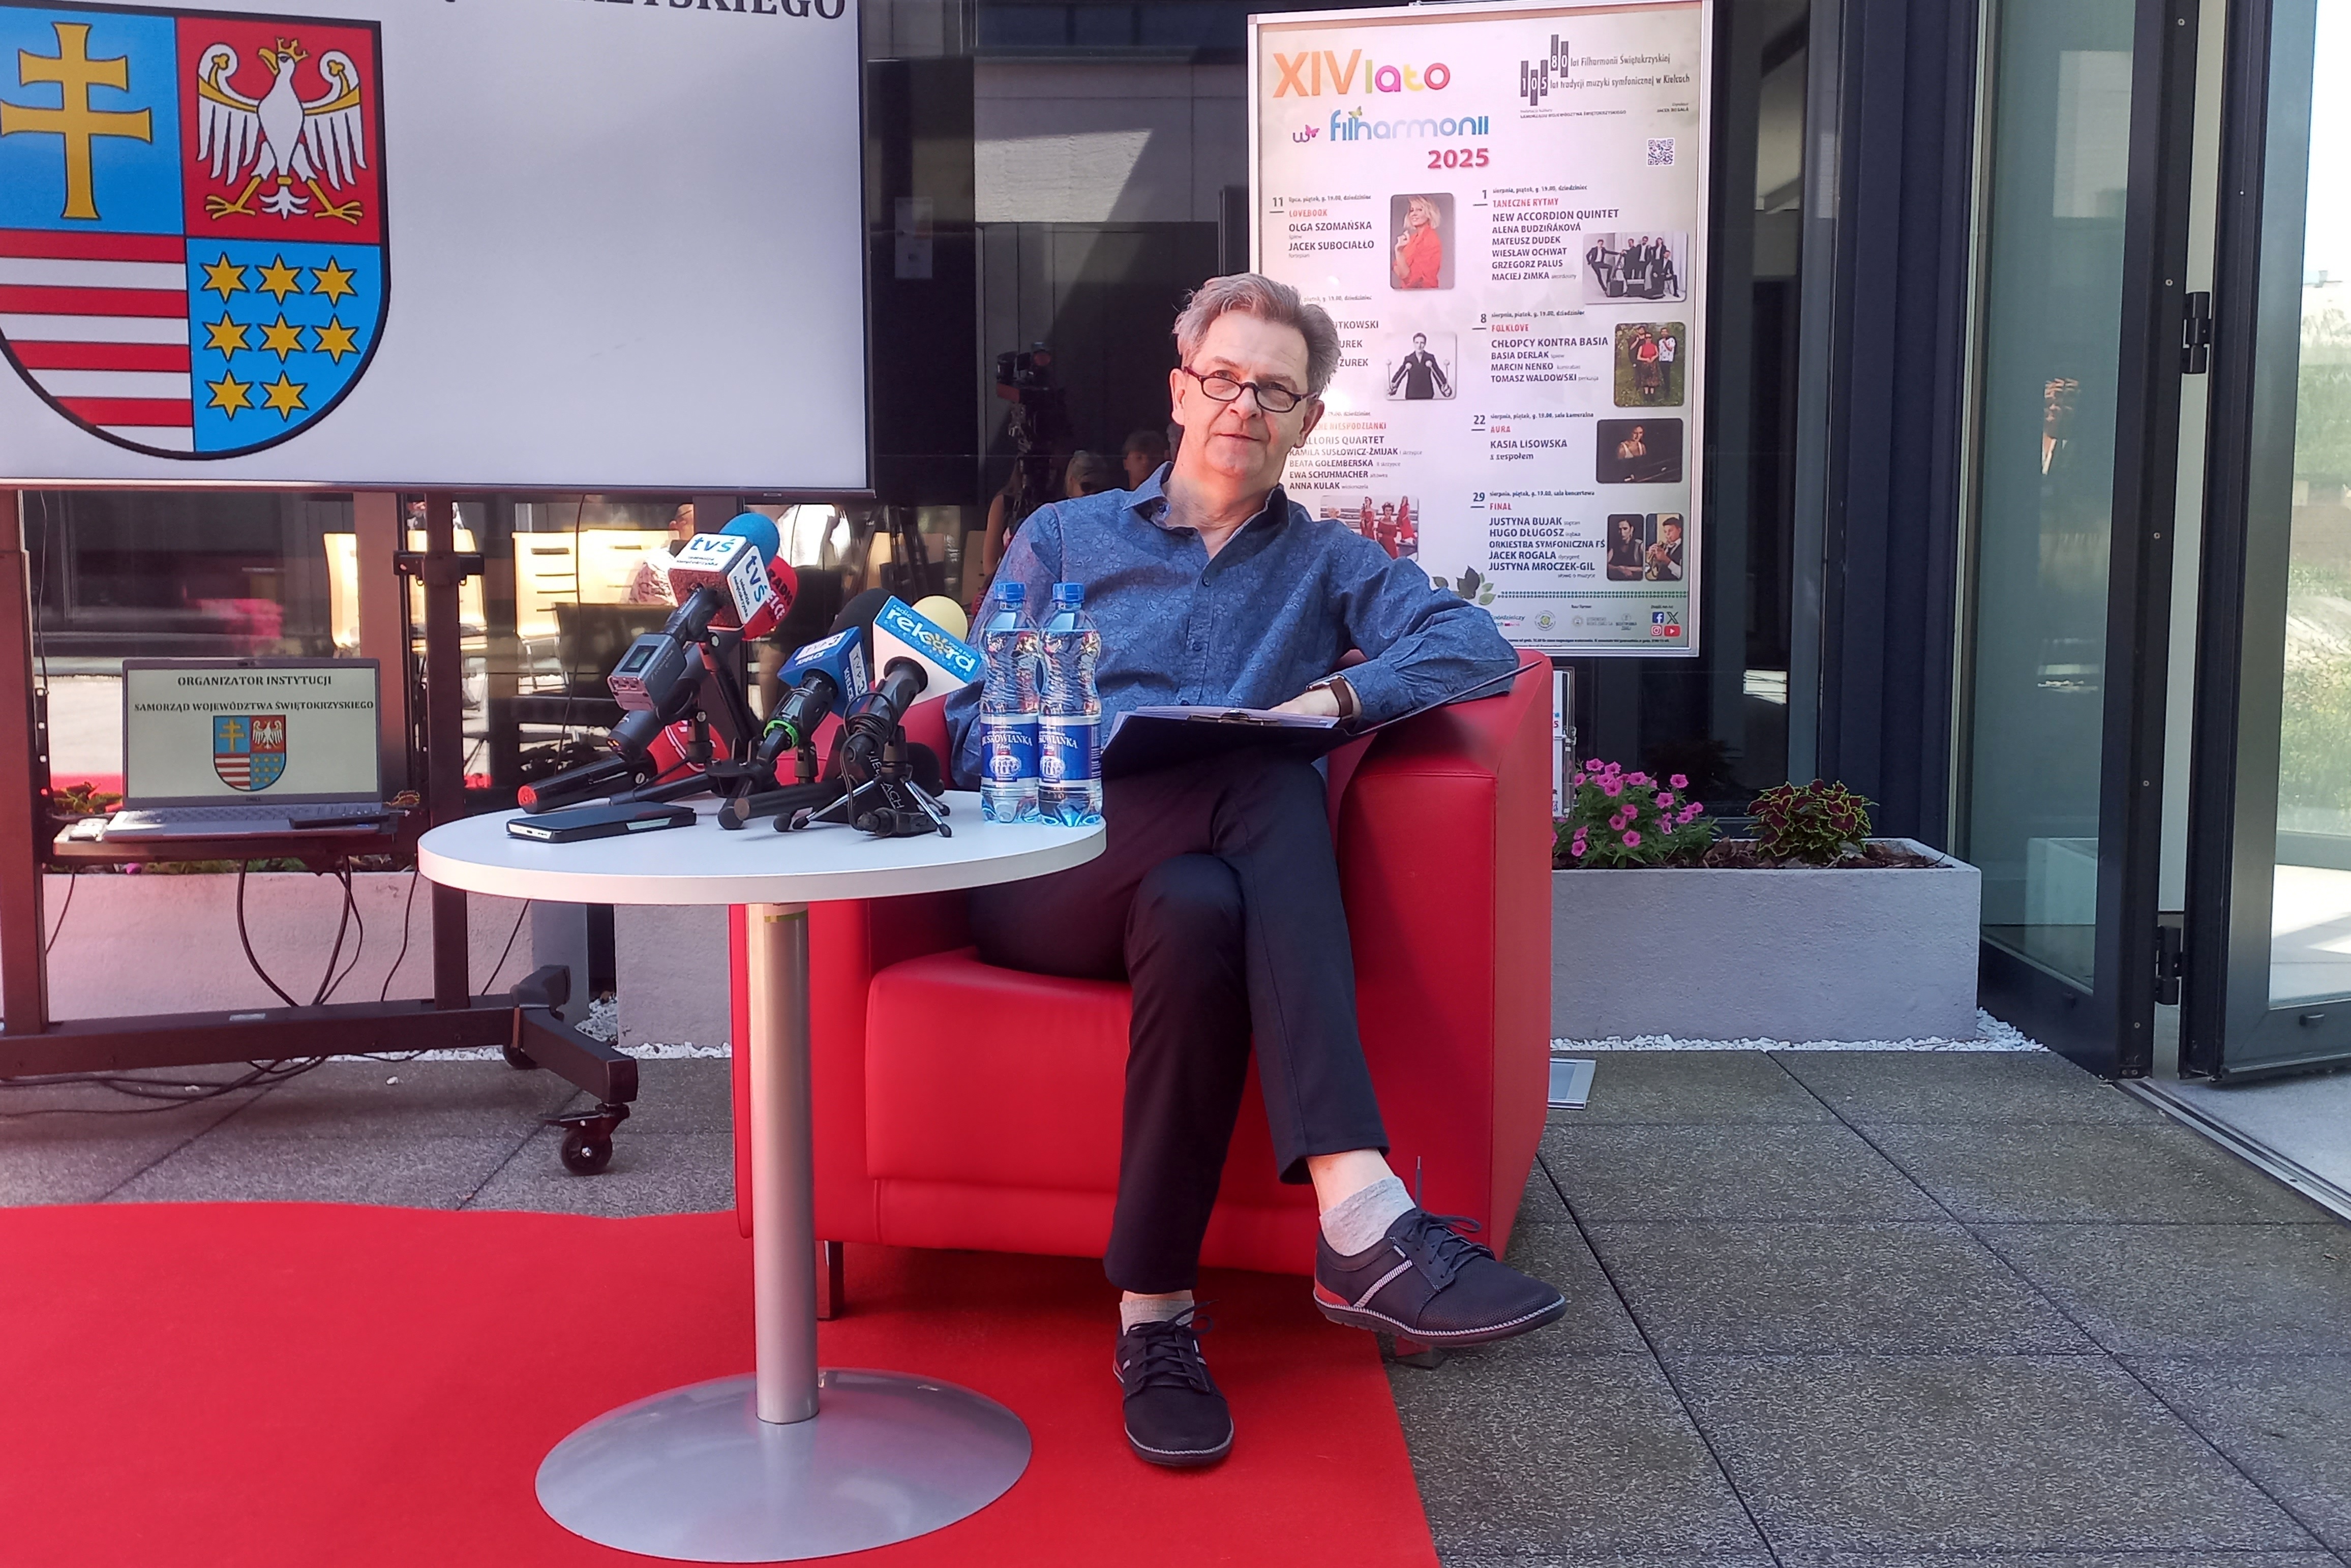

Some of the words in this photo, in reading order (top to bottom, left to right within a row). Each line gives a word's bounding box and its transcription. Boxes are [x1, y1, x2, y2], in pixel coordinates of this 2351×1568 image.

[1551, 55, 1568, 68] 80
[1571, 57, 1579, 67] lat
[1581, 56, 1618, 66] Filharmonii
[1273, 49, 1362, 98] XIV
[1366, 59, 1450, 94] lato
[1522, 76, 1547, 91] 105
[1550, 79, 1559, 88] lat
[1586, 77, 1610, 88] muzyki
[1612, 76, 1654, 87] symfonicznej
[1292, 132, 1310, 143] w
[1330, 109, 1489, 141] filharmonii
[1428, 148, 1490, 169] 2025
[1482, 190, 1487, 199] 1
[1272, 197, 1284, 207] 11
[1493, 199, 1530, 207] TANECZNE
[1532, 198, 1559, 206] RYTMY
[1289, 209, 1328, 217] LOVEBOOK
[1492, 213, 1515, 222] NEW
[1517, 210, 1574, 221] ACCORDION
[1576, 209, 1619, 220] QUINTET
[1289, 223, 1313, 232] OLGA
[1315, 220, 1372, 231] SZOMAŃSKA
[1288, 242, 1316, 251] JACEK
[1318, 240, 1374, 250] SUBOCIAŁŁO
[1492, 236, 1530, 245] MATEUSZ
[1532, 236, 1561, 244] DUDEK
[1492, 248, 1530, 257] WIESŁAW
[1532, 248, 1568, 256] OCHWAT
[1492, 260, 1535, 269] GRZEGORZ
[1537, 259, 1563, 267] PALUS
[1492, 272, 1521, 281] MACIEJ
[1523, 272, 1550, 280] ZIMKA
[1481, 313, 1487, 323] 8
[1339, 340, 1363, 348] UREK
[1491, 339, 1535, 348] CHŁOPCY
[1538, 338, 1577, 347] KONTRA
[1579, 337, 1608, 346] BASIA
[1491, 352, 1515, 360] BASIA
[1517, 351, 1549, 359] DERLAK
[1491, 363, 1523, 371] MARCIN
[1525, 362, 1553, 371] NENKO
[1491, 374, 1524, 383] TOMASZ
[1526, 373, 1577, 382] WALDOWSKI
[1473, 415, 1486, 425] 22
[1342, 436, 1384, 445] QUARTET
[1490, 440, 1518, 449] KASIA
[1520, 439, 1568, 448] LISOWSKA
[1496, 453, 1534, 462] zespołem
[1308, 470, 1368, 478] SCHUHMACHER
[1314, 481, 1340, 490] KULAK
[1473, 492, 1485, 502] 29
[1489, 517, 1530, 526] JUSTYNA
[1532, 517, 1562, 526] BUJAK
[1489, 529, 1517, 537] HUGO
[1520, 528, 1564, 537] DŁUGOSZ
[690, 536, 736, 553] tvś
[1489, 540, 1533, 549] ORKIESTRA
[1535, 540, 1594, 548] SYMFONICZNA
[1489, 551, 1517, 560] JACEK
[1519, 551, 1556, 559] ROGALA
[1489, 562, 1529, 571] JUSTYNA
[1531, 562, 1595, 570] MROCZEK-GIL
[745, 555, 769, 602] tvś
[766, 590, 786, 620] ELCE
[892, 604, 913, 619] radio
[886, 608, 976, 673] rekord
[177, 676, 263, 687] ORGANIZATOR
[266, 675, 332, 686] INSTYTUCJI
[843, 666, 854, 702] KIELCE
[134, 702, 190, 713] SAMORZĄD
[192, 700, 273, 711] WOJEWÓDZTWA
[275, 699, 374, 711] ŚWIĘTOKRZYSKIEGO
